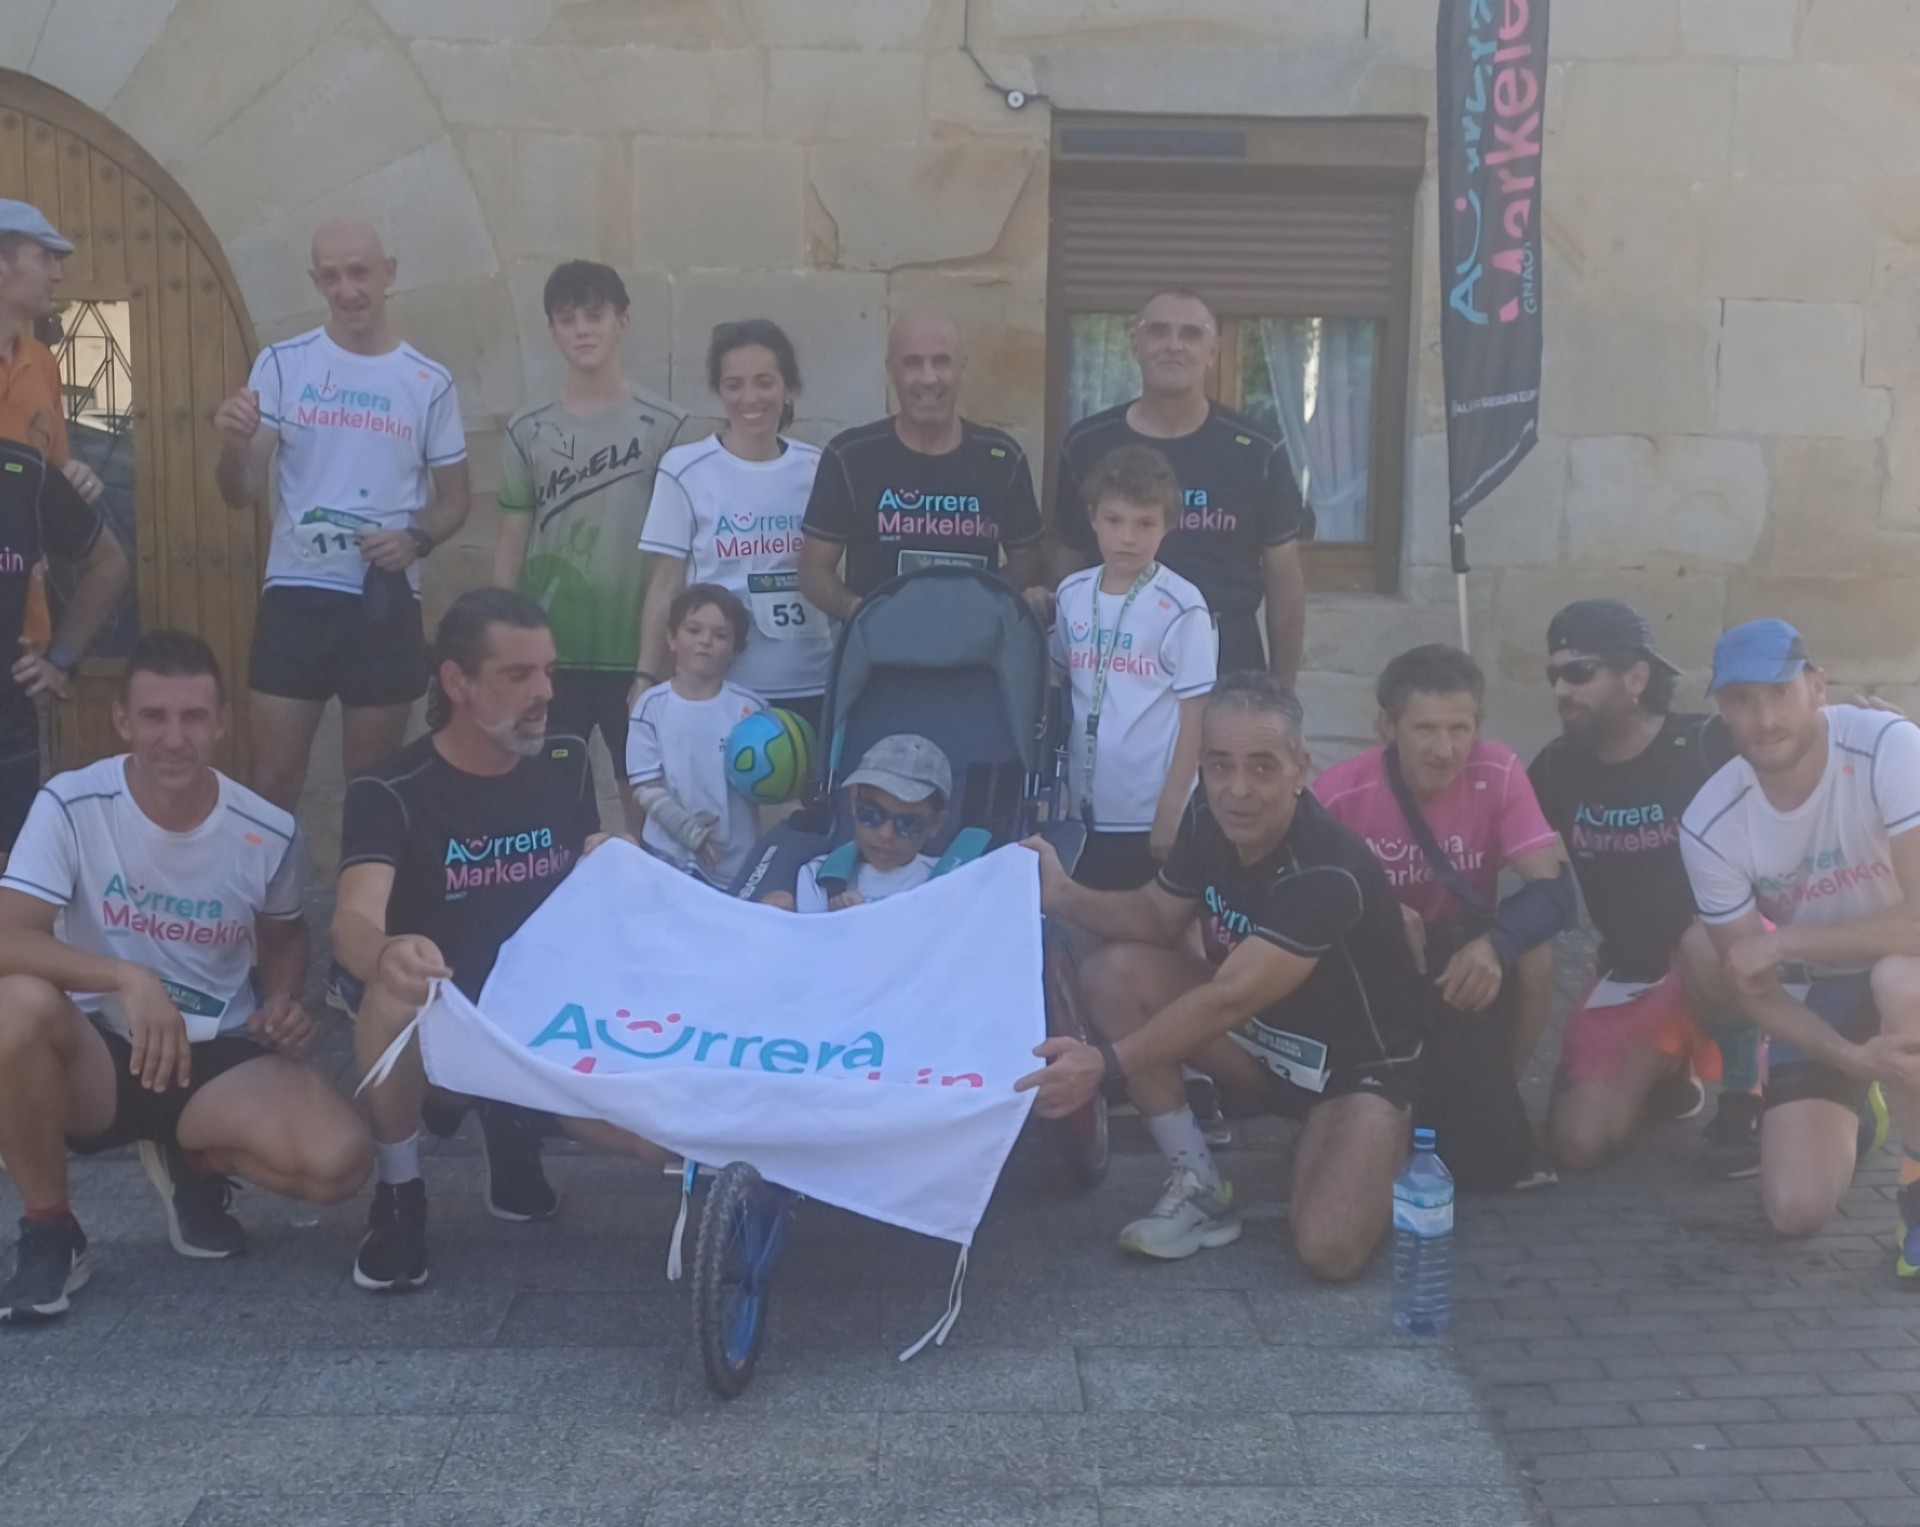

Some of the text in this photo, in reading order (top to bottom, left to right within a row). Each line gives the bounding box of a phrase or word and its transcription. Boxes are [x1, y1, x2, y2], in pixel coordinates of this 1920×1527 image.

[297, 405, 413, 441] Markelekin
[879, 488, 980, 513] Aurrera
[877, 511, 999, 540] Markelekin
[716, 531, 804, 559] Markele
[772, 602, 806, 627] 53
[445, 827, 553, 866] Aurrera
[528, 1002, 885, 1074] Aurrera
